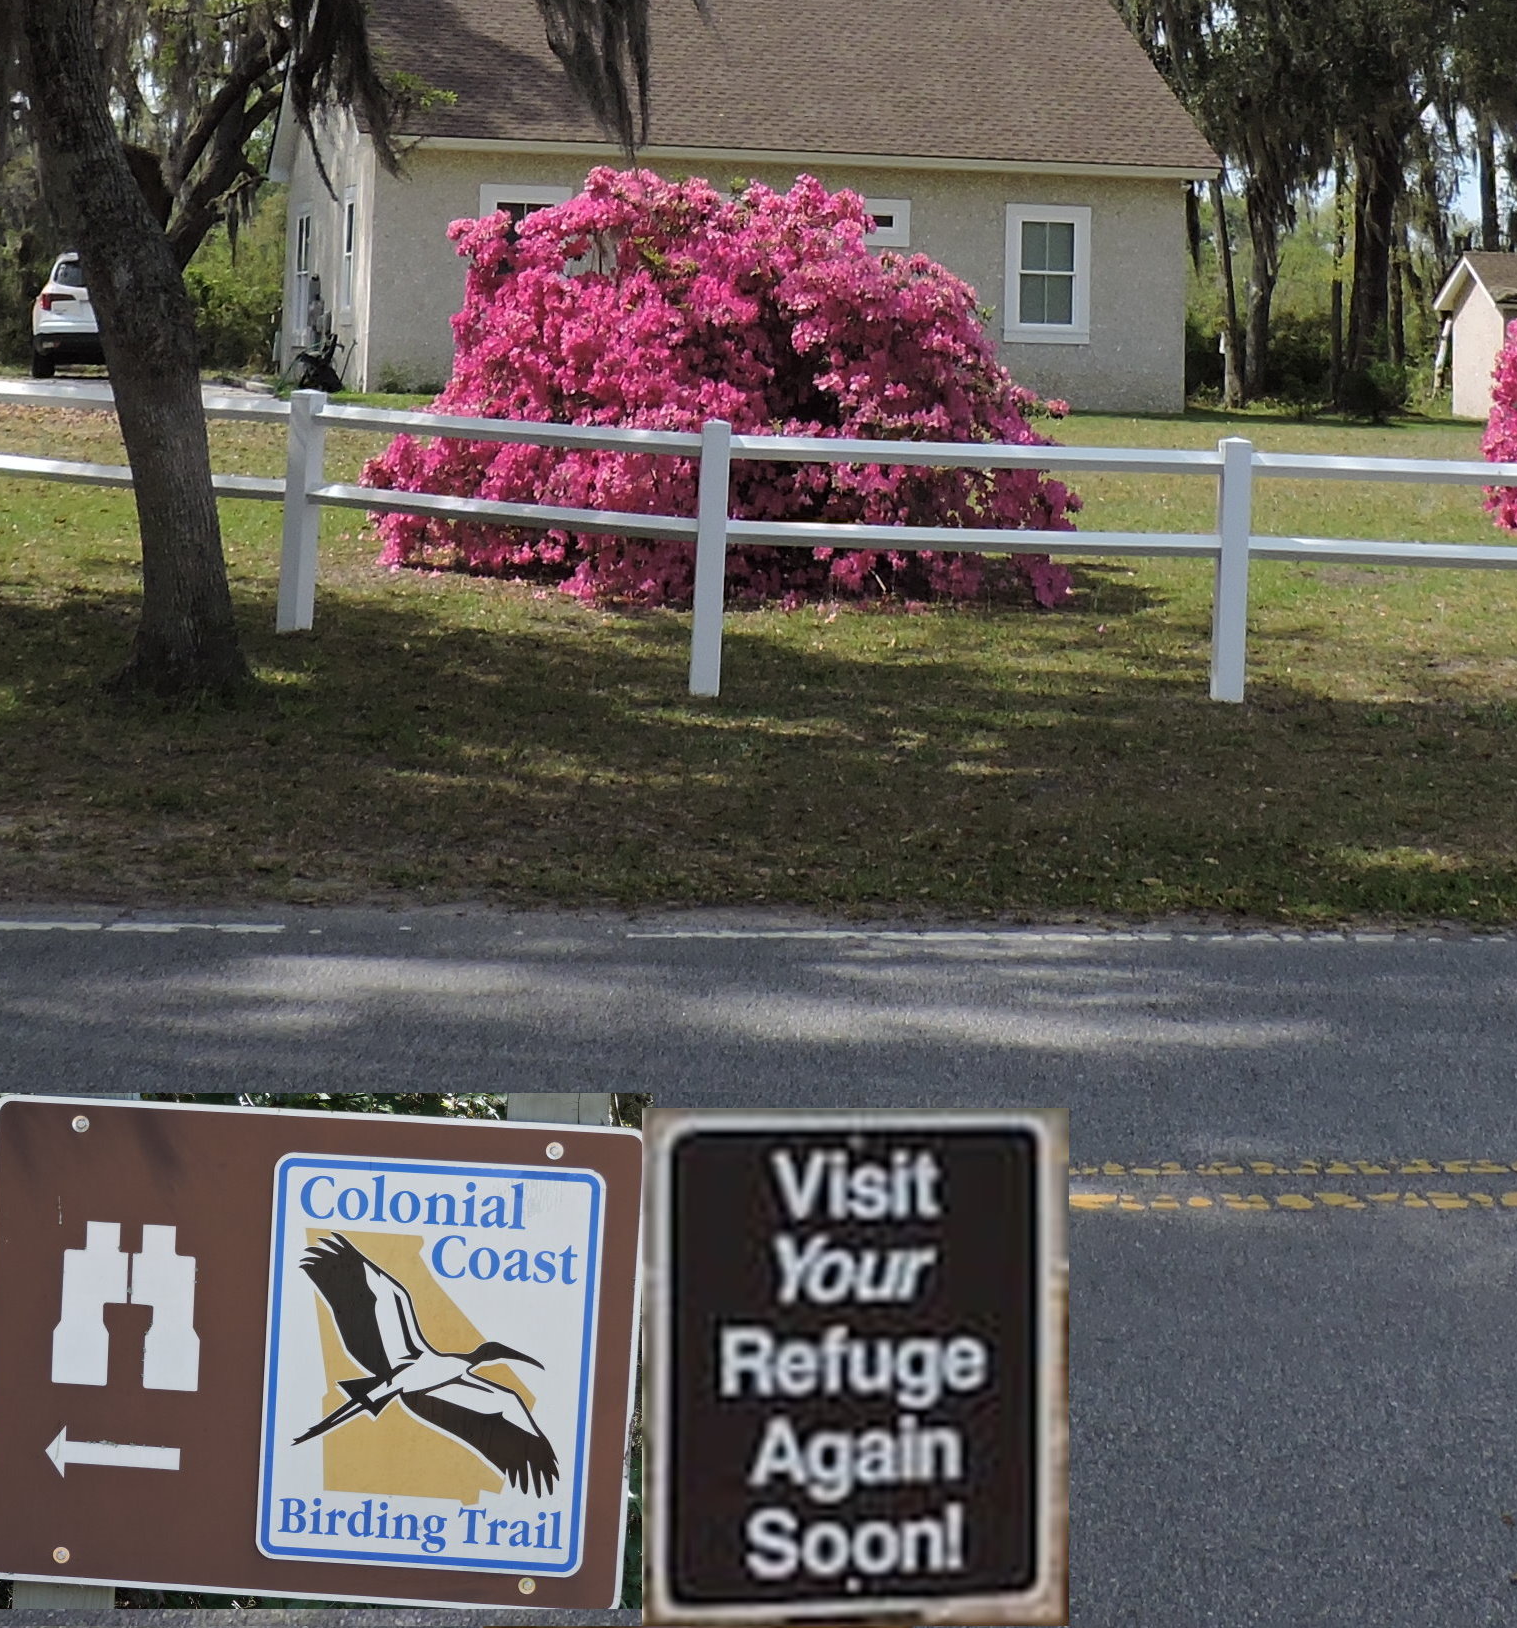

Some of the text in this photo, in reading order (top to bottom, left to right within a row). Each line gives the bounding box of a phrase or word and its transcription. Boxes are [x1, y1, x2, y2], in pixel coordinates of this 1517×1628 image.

[299, 1175, 526, 1230] Colonial
[773, 1150, 940, 1220] Visit
[431, 1235, 579, 1285] Coast
[774, 1234, 937, 1304] Your
[720, 1325, 986, 1409] Refuge
[748, 1415, 962, 1503] Again
[277, 1497, 563, 1554] Birding Trail
[746, 1503, 963, 1579] Soon!
